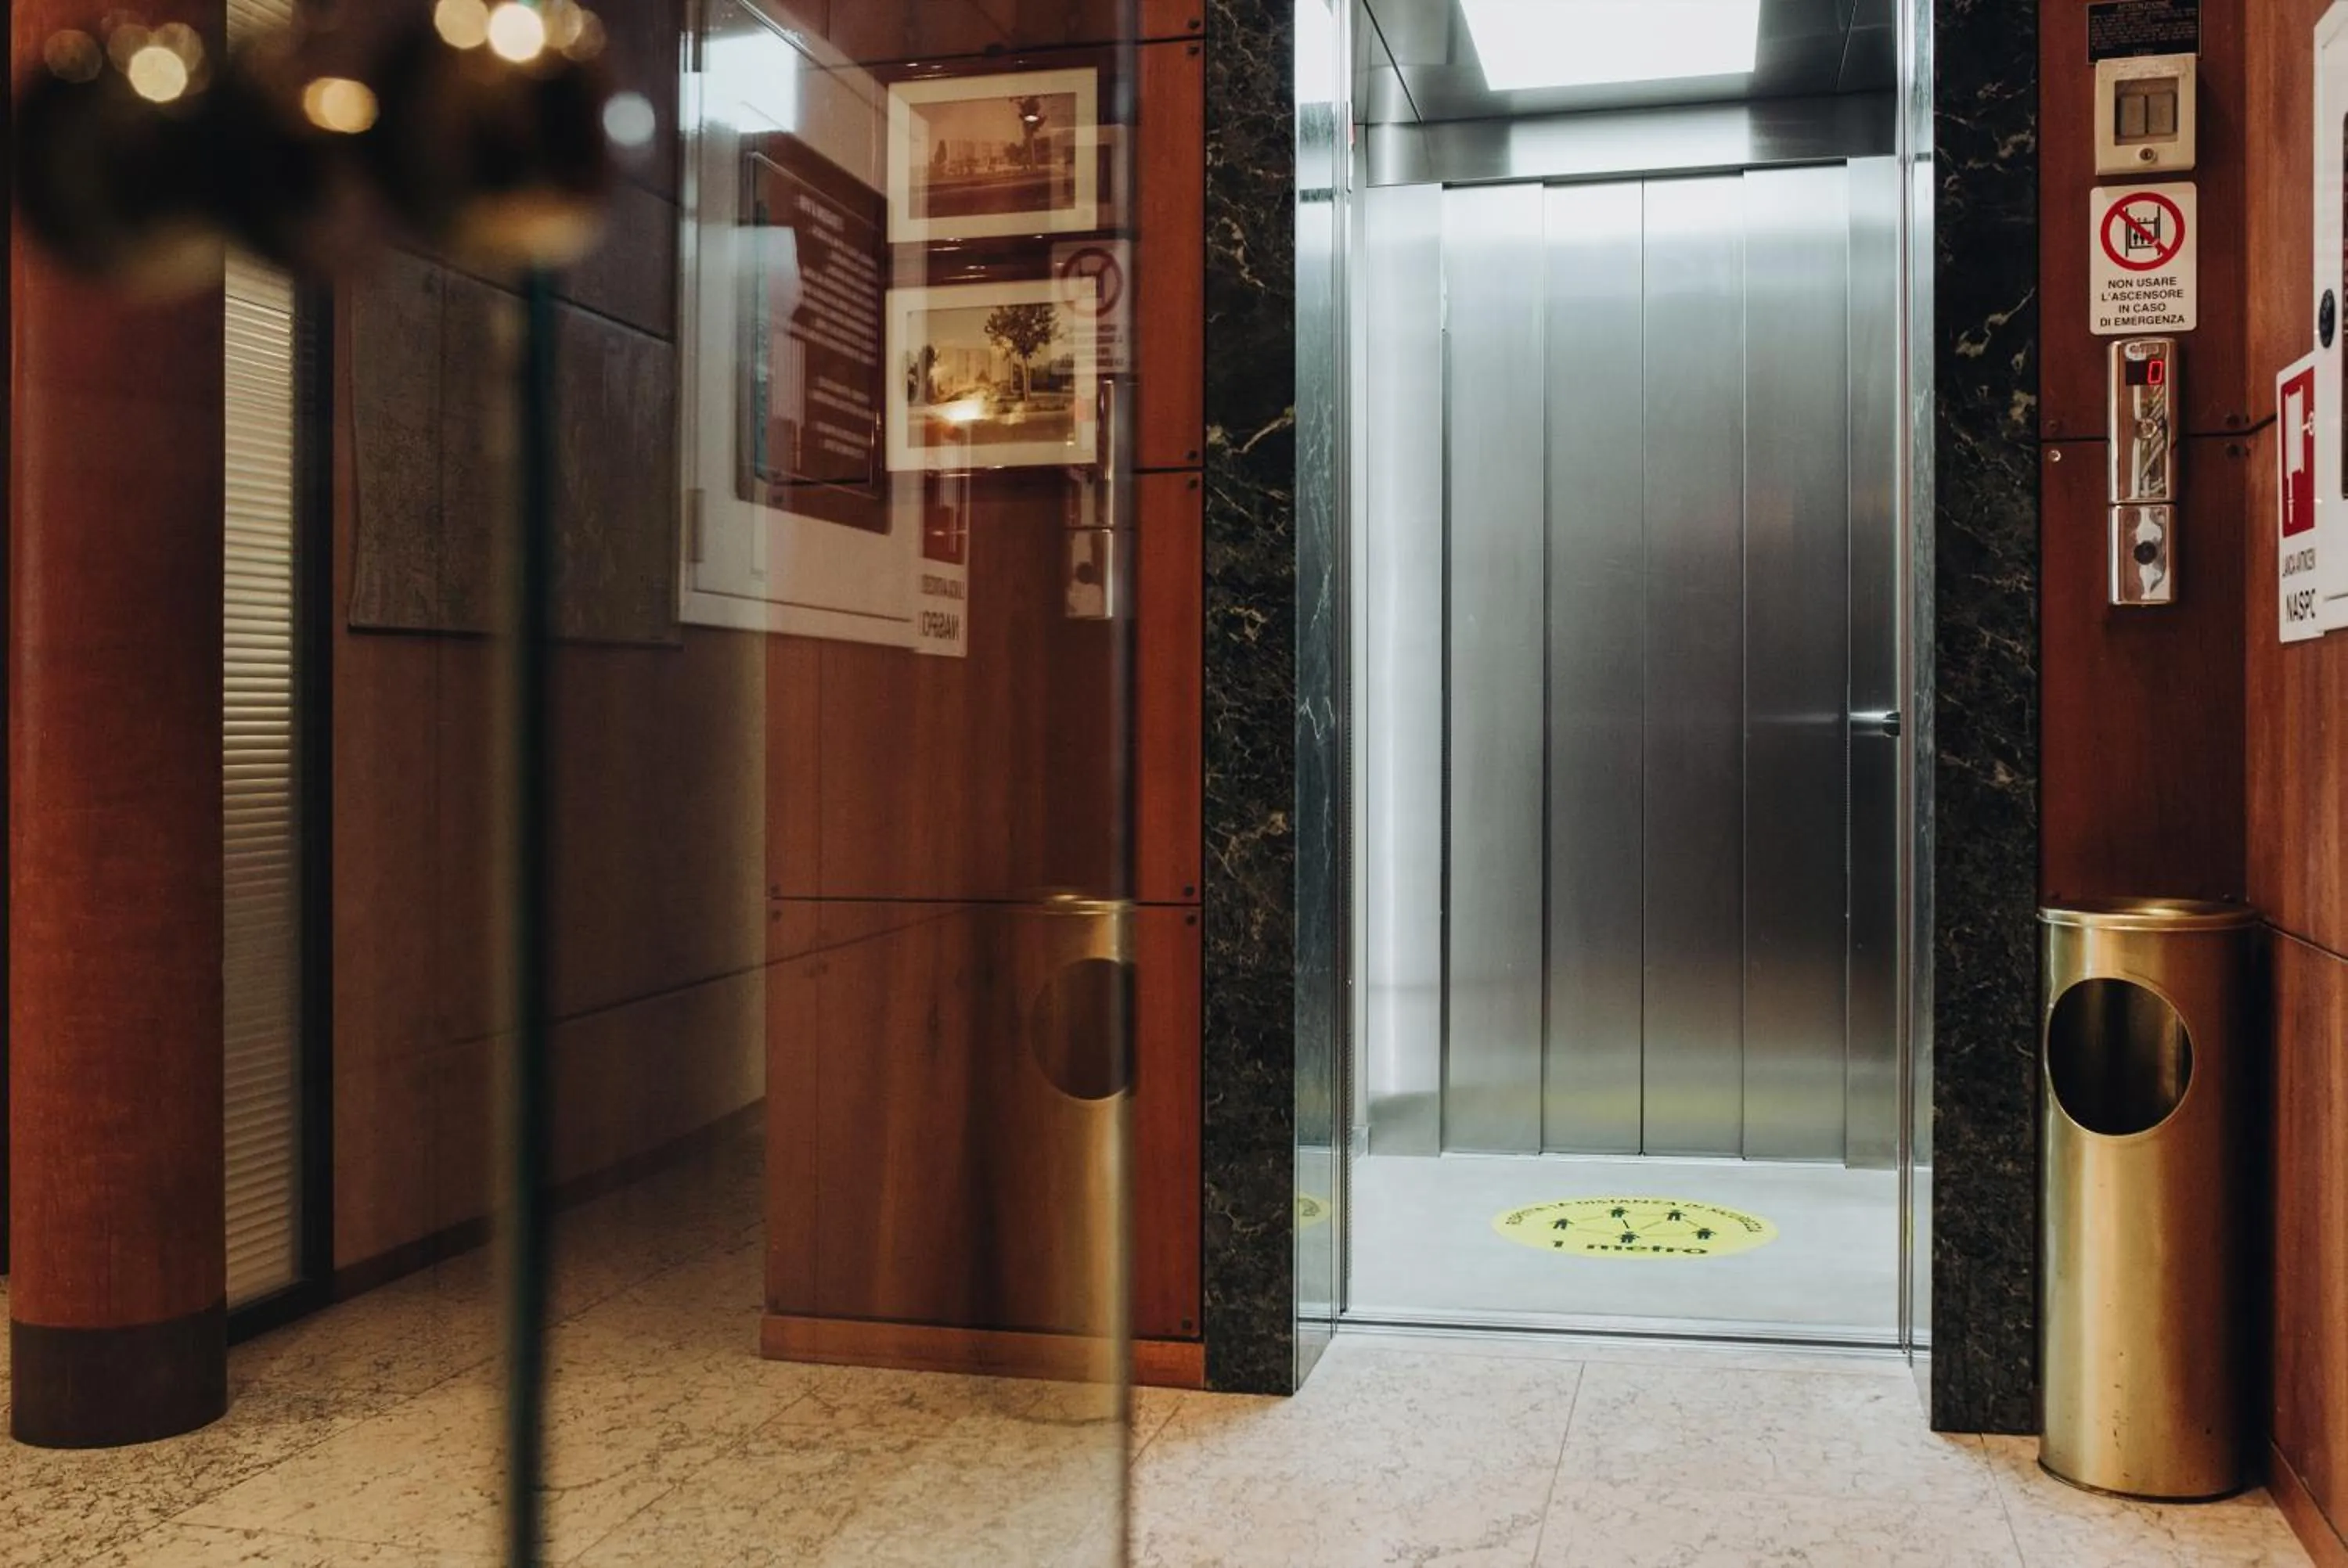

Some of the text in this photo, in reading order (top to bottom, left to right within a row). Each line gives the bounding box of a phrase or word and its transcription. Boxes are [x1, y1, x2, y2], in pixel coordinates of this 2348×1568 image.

[2108, 276, 2177, 289] NON USARE
[2101, 289, 2184, 301] L'ASCENSORE
[2119, 303, 2166, 313] IN CASO
[2100, 315, 2185, 326] DI EMERGENZA
[1553, 1239, 1708, 1254] 1 metro
